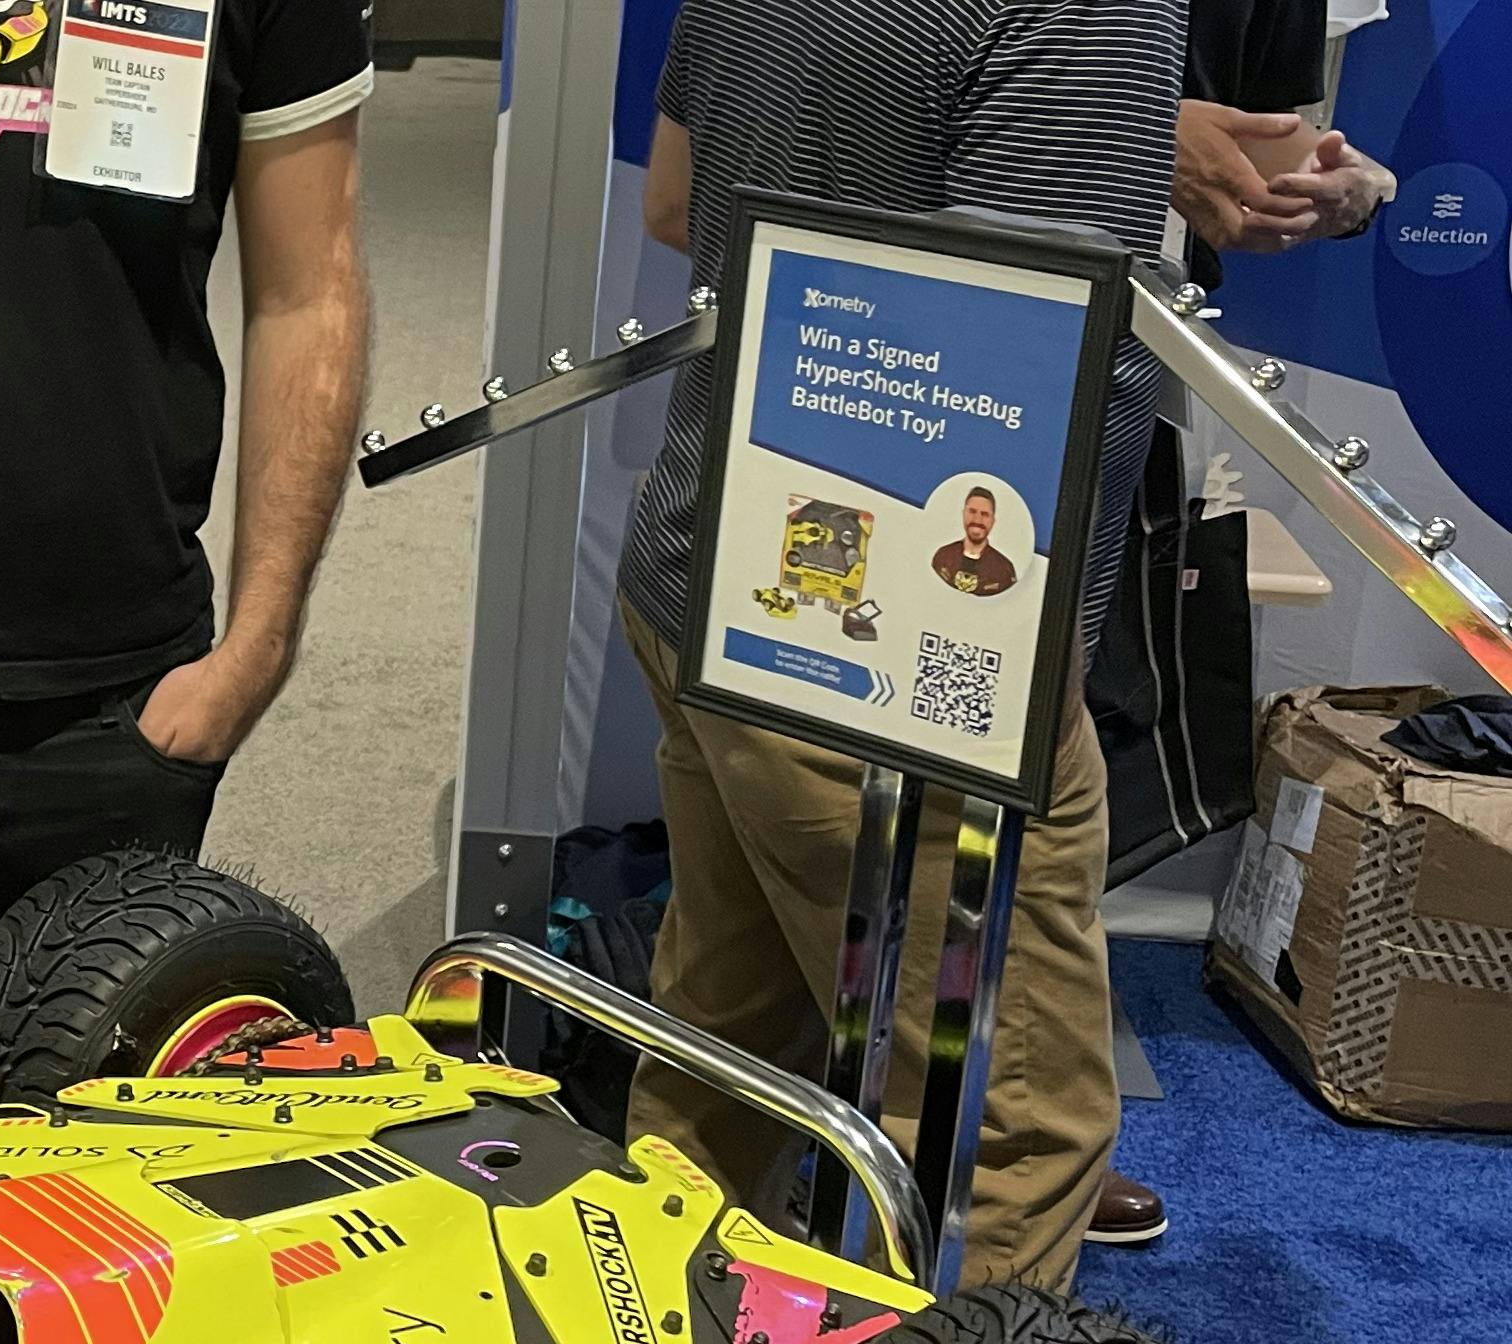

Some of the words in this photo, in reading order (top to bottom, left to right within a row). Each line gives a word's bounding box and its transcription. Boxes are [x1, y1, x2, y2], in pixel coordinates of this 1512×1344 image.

[92, 56, 122, 74] WILL
[126, 61, 166, 81] BALES
[93, 165, 142, 183] EXHIBITOR
[1398, 226, 1488, 245] Selection
[803, 287, 876, 319] Xometry
[799, 324, 842, 352] Win
[847, 338, 861, 355] a
[866, 338, 940, 373] Signed
[796, 355, 927, 403] HyperShock
[932, 385, 1023, 430] HexBug
[791, 386, 895, 428] BattleBot
[900, 409, 946, 443] Toy!
[140, 1089, 424, 1110] SendCutSend
